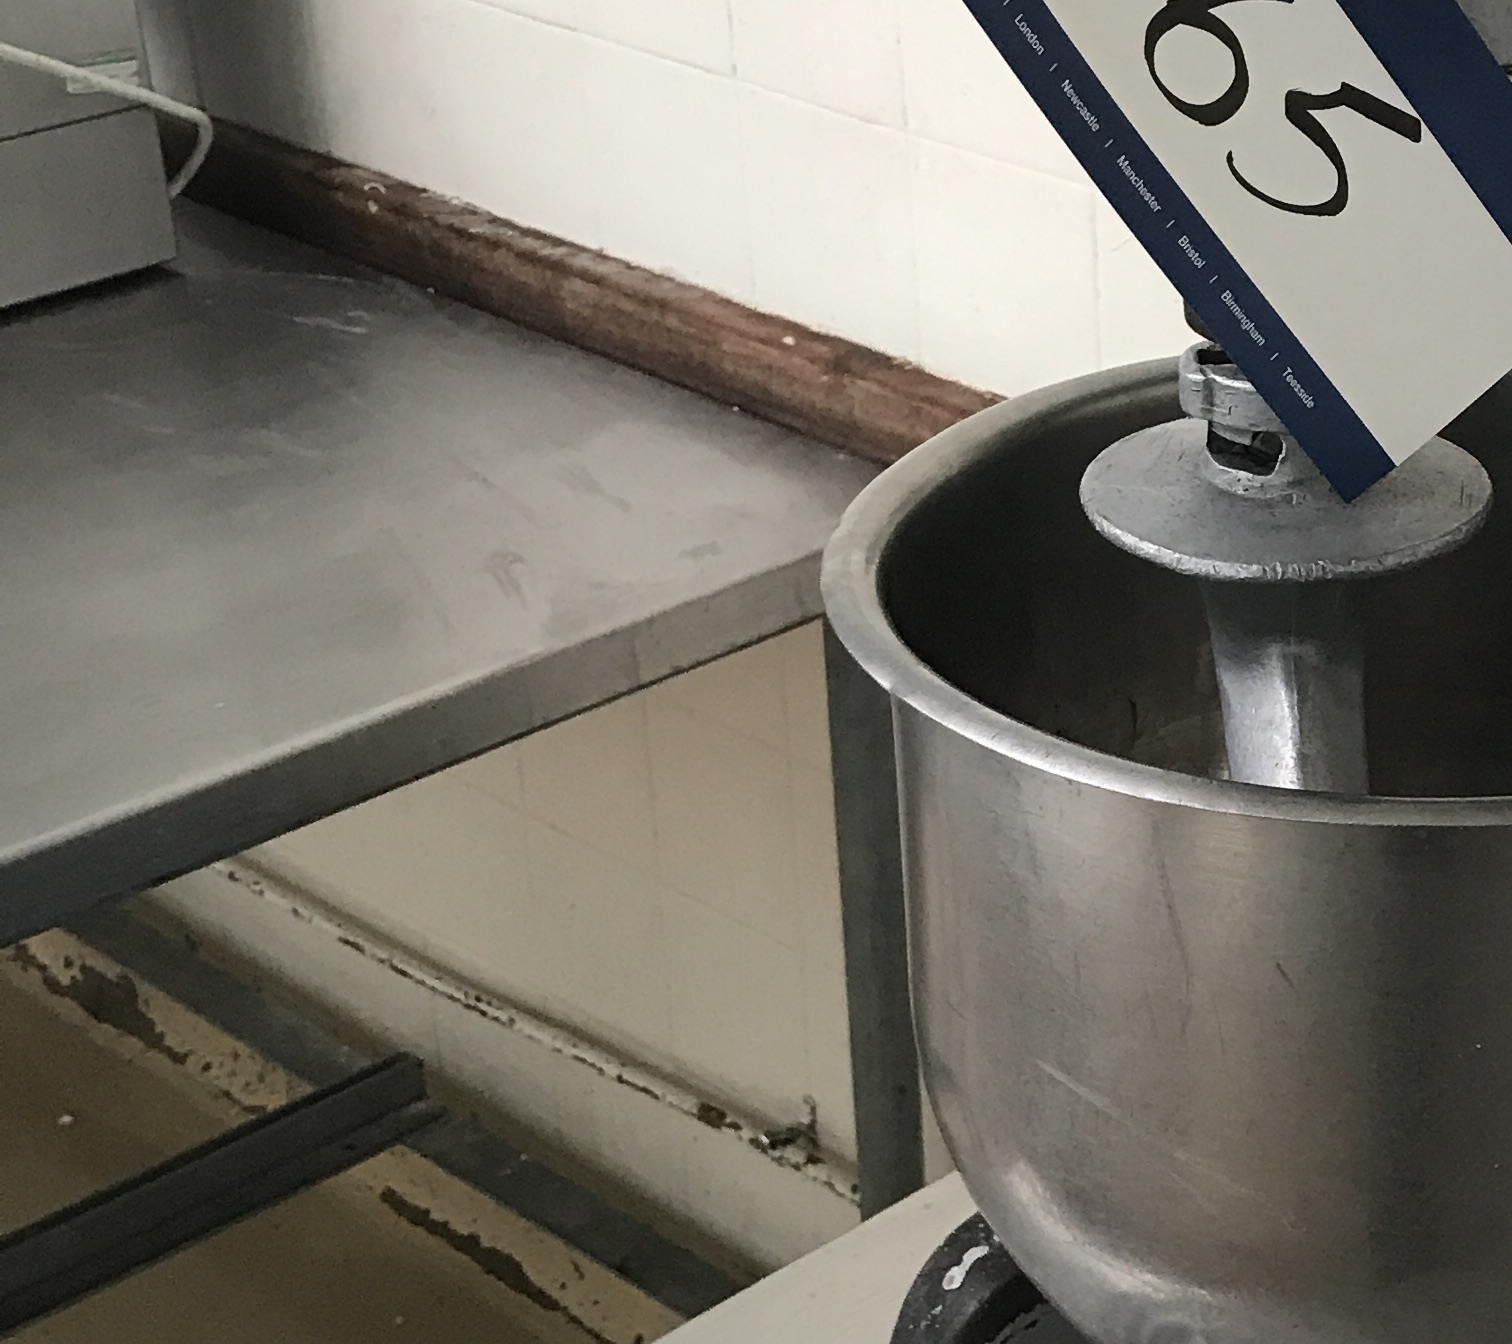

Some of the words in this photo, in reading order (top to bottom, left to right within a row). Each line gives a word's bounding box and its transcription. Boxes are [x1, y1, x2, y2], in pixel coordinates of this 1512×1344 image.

[1014, 13, 1045, 56] London
[1060, 79, 1100, 132] Newcastle
[1116, 154, 1162, 213] Manchester
[1177, 235, 1206, 269] Bristol
[1220, 289, 1266, 347] Birmingham
[1282, 366, 1315, 409] Teesside
